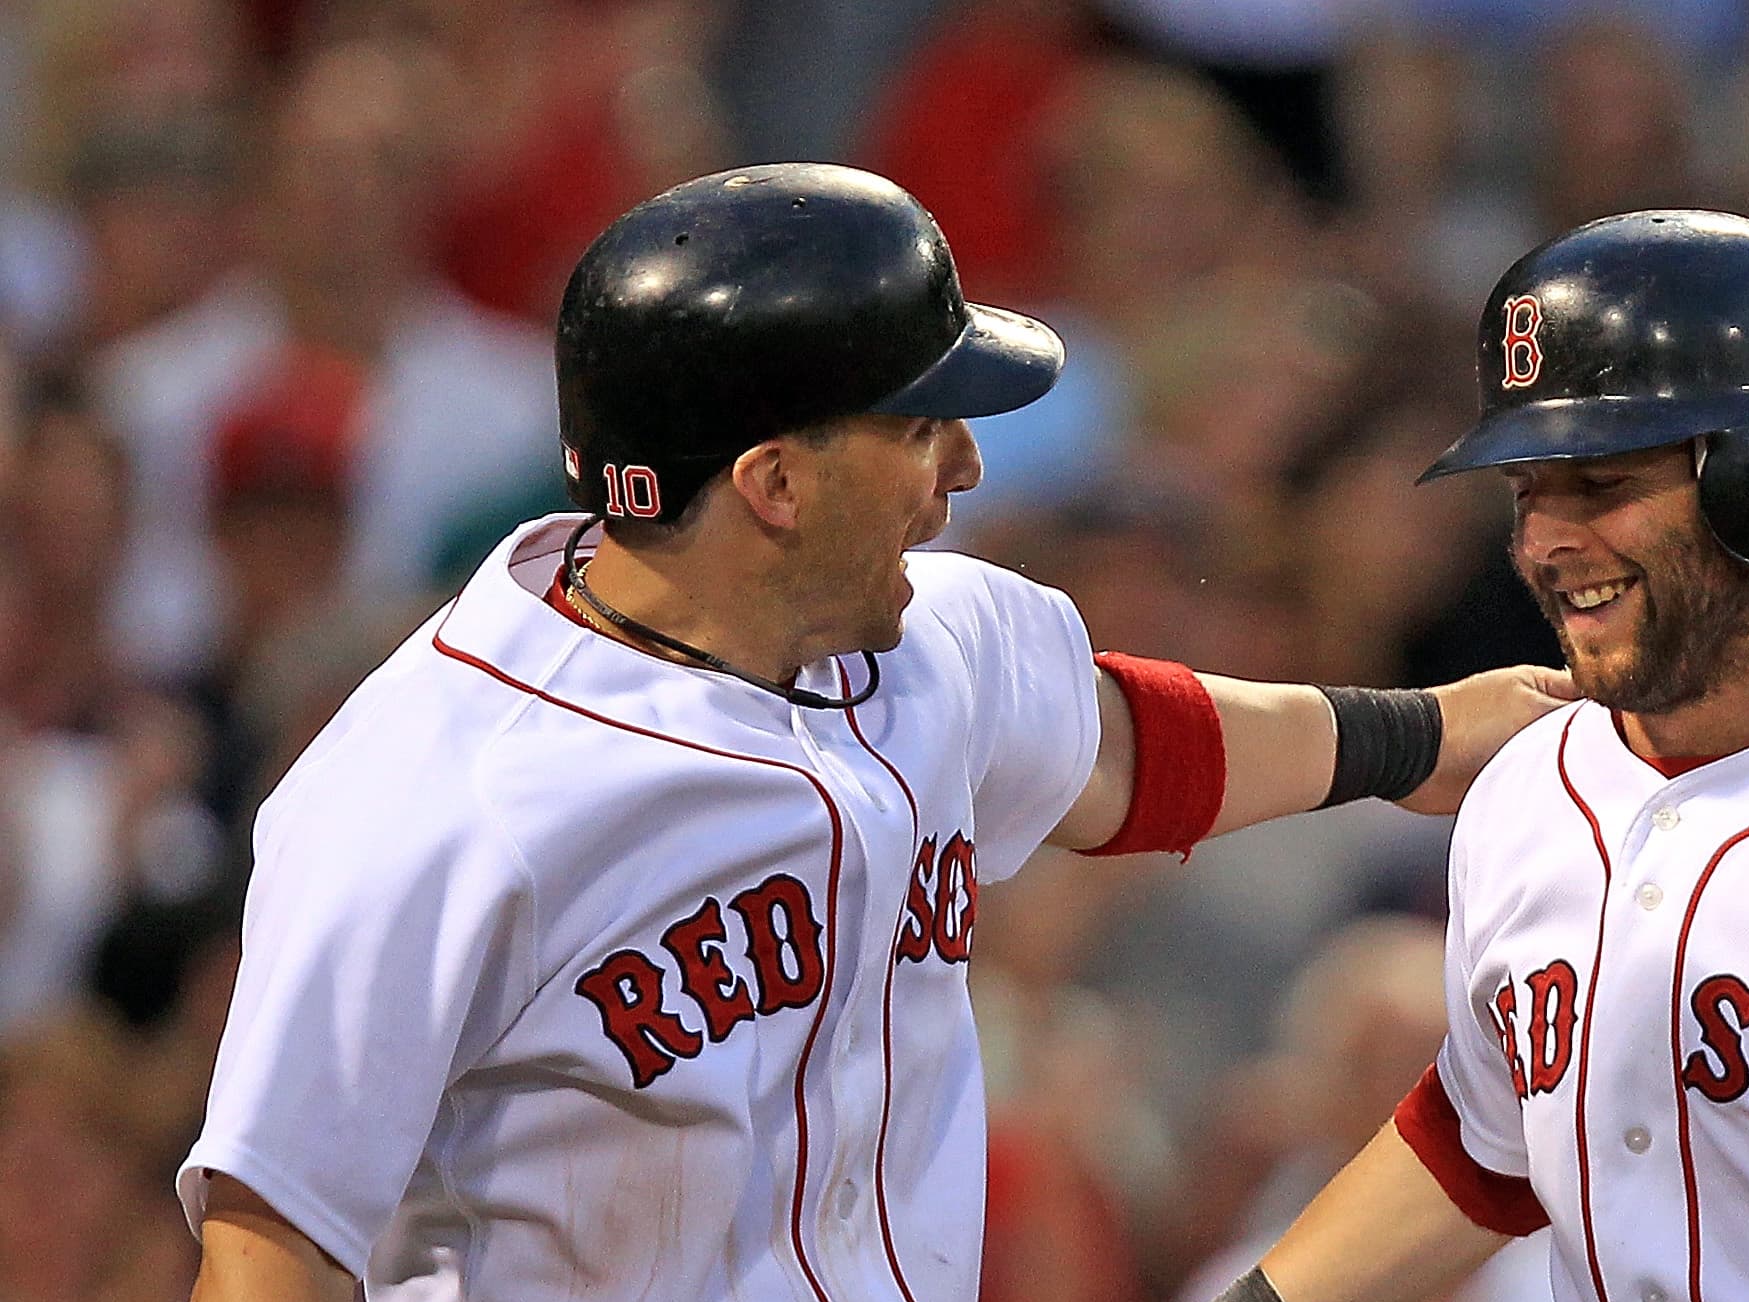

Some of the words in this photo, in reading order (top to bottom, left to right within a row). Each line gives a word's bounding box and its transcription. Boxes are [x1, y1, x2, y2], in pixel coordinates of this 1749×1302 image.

[1502, 294, 1544, 389] B
[603, 463, 661, 518] 10
[574, 873, 825, 1090] RED
[1487, 957, 1579, 1101] ED
